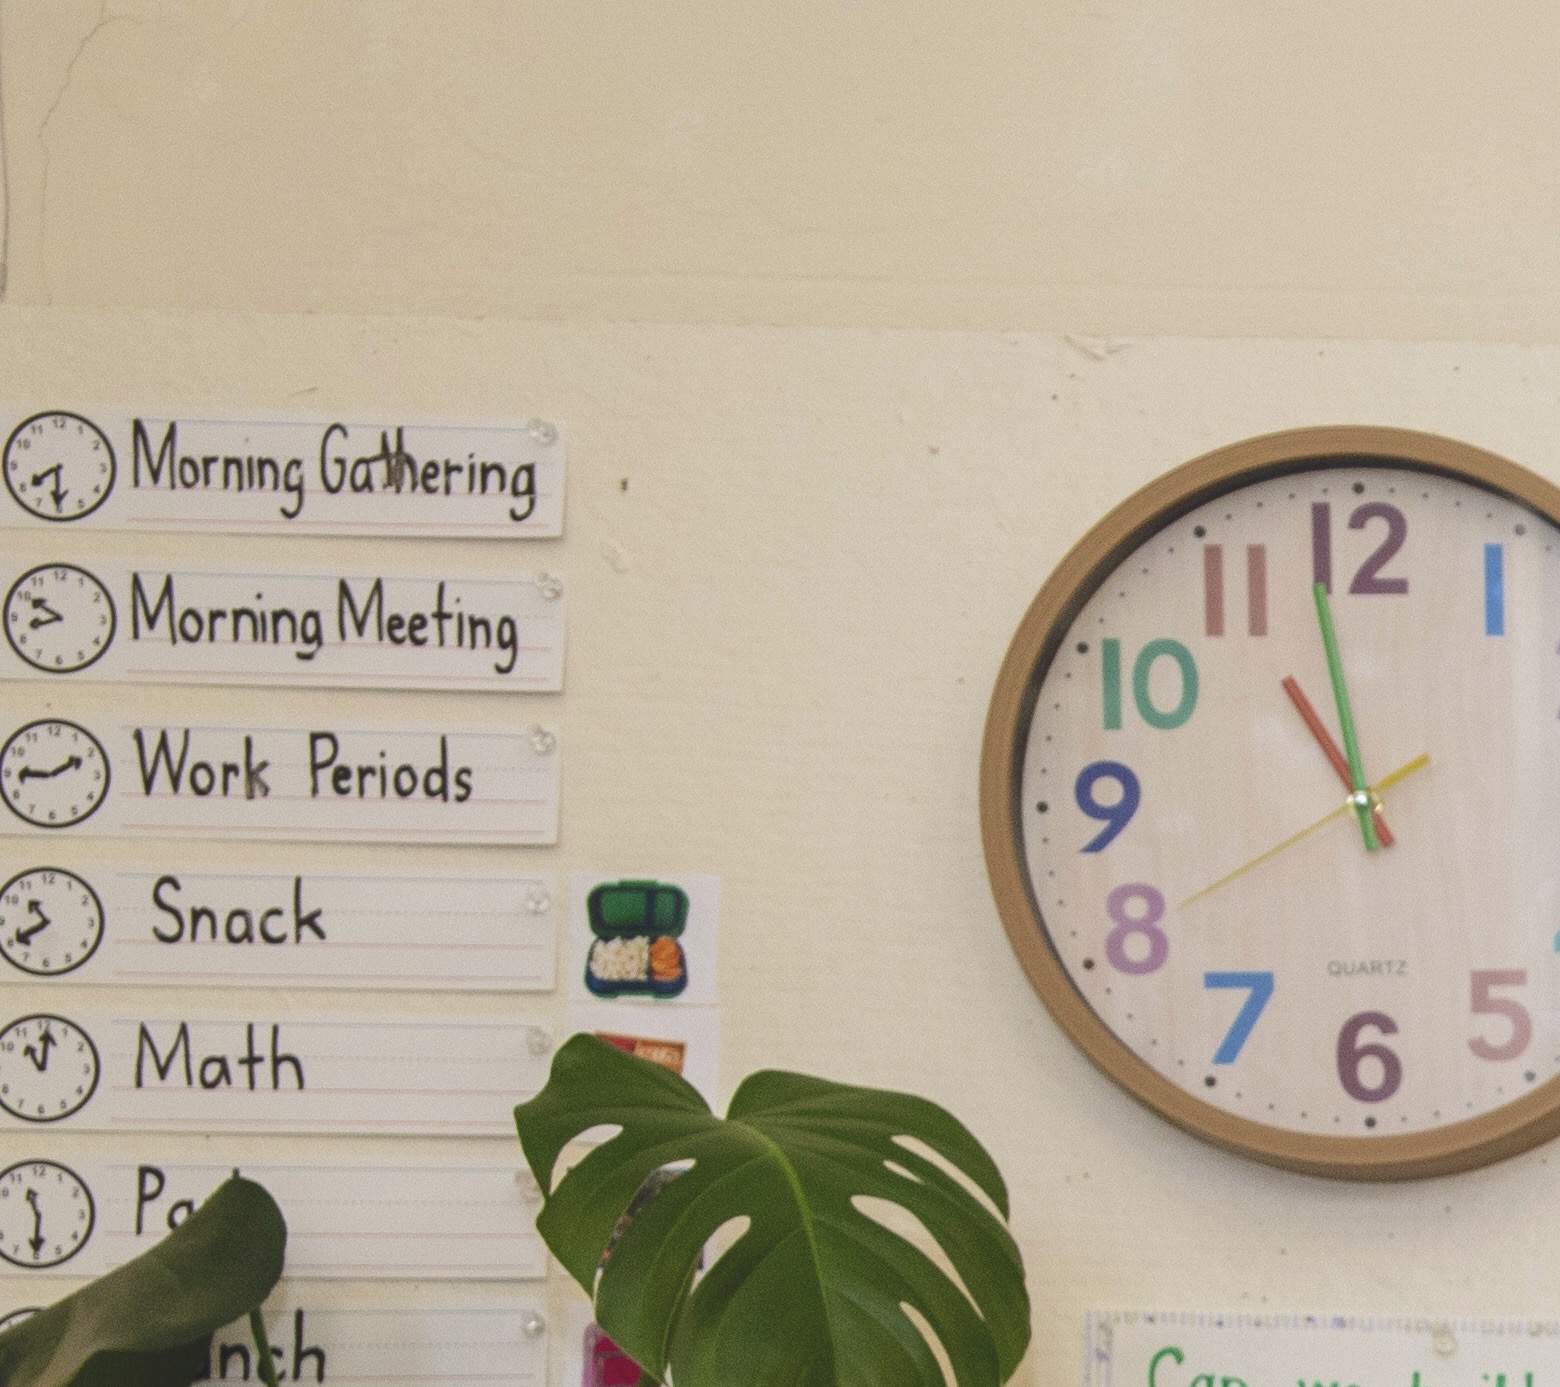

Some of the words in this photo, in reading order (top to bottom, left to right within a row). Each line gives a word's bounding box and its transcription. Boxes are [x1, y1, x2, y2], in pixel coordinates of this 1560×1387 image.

[133, 418, 305, 518] Morning
[321, 423, 537, 521] Gathering
[1203, 543, 1268, 637] 11
[1310, 501, 1410, 595] 12
[1484, 543, 1504, 636] 1
[132, 572, 323, 660] Morning
[338, 578, 519, 674] Meeting
[1101, 637, 1199, 731] 10
[133, 728, 270, 799] Work
[310, 731, 473, 803] Periods
[1074, 760, 1141, 854] 9
[152, 876, 326, 945] Snack
[1105, 883, 1169, 975] 8
[1327, 959, 1409, 977] QUARTZ
[134, 1021, 305, 1091] Math
[1203, 971, 1275, 1065] 7
[1336, 1011, 1403, 1103] 6
[1468, 969, 1533, 1062] 5
[203, 1308, 326, 1383] nch
